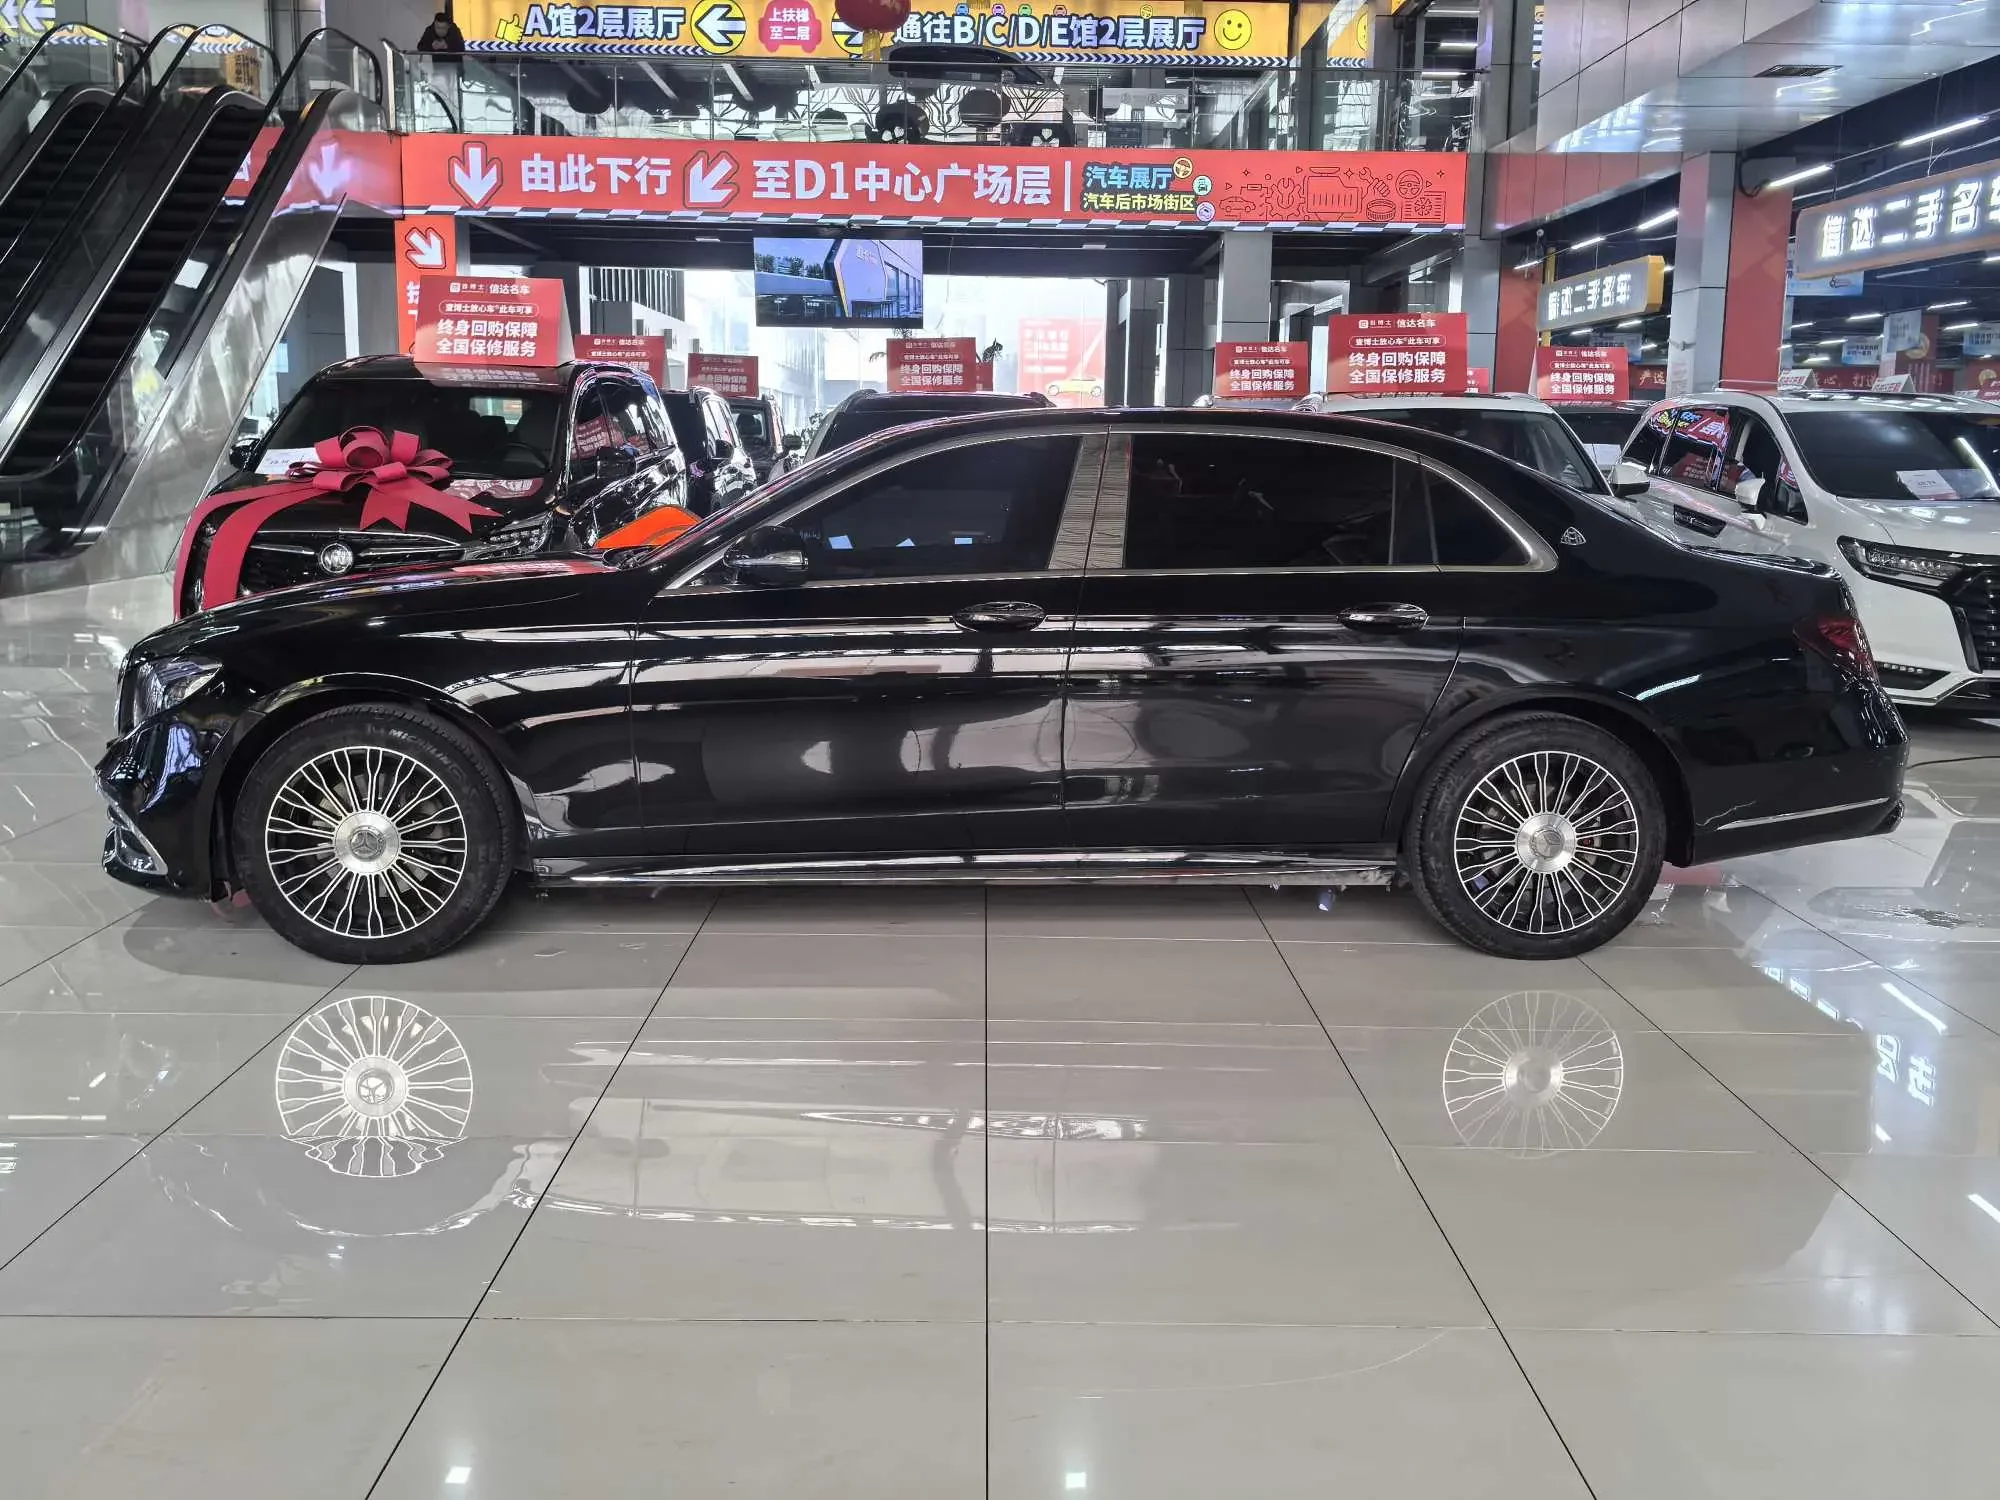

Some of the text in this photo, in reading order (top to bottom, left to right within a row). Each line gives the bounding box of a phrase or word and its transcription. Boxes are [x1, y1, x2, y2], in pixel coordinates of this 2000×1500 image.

[524, 4, 686, 40] A馆2层展厅
[768, 8, 810, 23] 上扶梯
[769, 25, 811, 41] 至二层
[893, 14, 1206, 49] 通往B/C/D/E馆2层展厅
[521, 152, 1052, 206] 由此下行 至D1中心广场层
[1085, 165, 1173, 190] 汽车展厅
[1083, 192, 1196, 211] 汽车后市场街区
[489, 283, 531, 295] 信达名车
[1548, 273, 1632, 321] 信达二手名车
[436, 319, 538, 338] 终身回购保障
[1397, 319, 1437, 328] 信达名车
[436, 338, 537, 357] 全国保修服务
[1348, 351, 1446, 366] 终身回购保障
[900, 363, 963, 375] 终身回购保障
[1229, 369, 1295, 379] 终身回购保障
[1349, 368, 1446, 384] 全国保修服务
[900, 375, 963, 386] 全国保修服务
[1550, 372, 1615, 383] 终身回购保障
[1230, 381, 1295, 391] 全国保修服务
[1551, 384, 1615, 395] 全国保修服务
